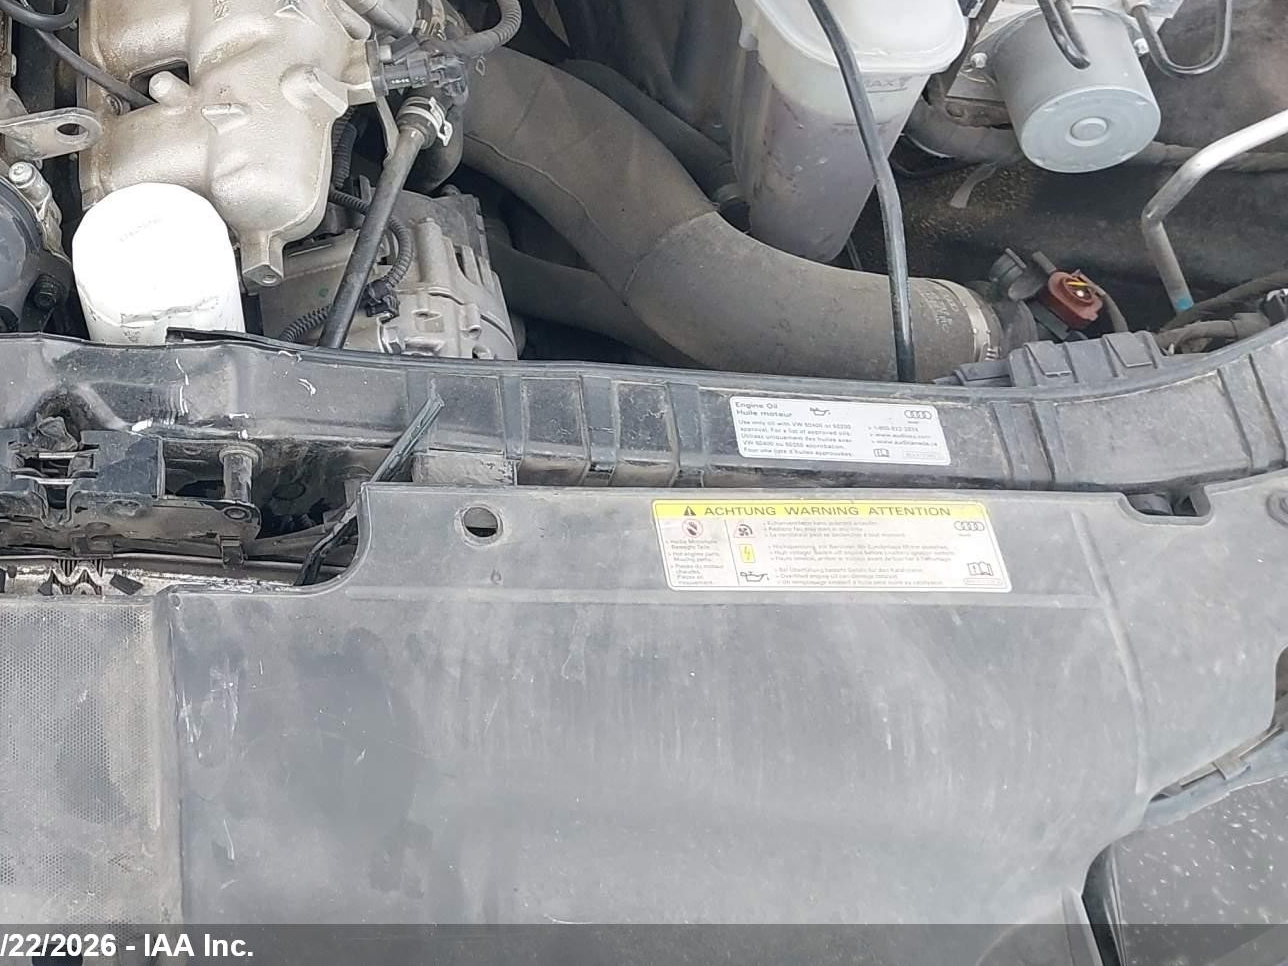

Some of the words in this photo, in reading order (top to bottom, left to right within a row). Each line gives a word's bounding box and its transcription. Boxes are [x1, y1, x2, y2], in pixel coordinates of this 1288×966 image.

[704, 507, 776, 516] ACHTUNG
[784, 507, 859, 516] WARNING
[868, 507, 951, 516] ATTENTION
